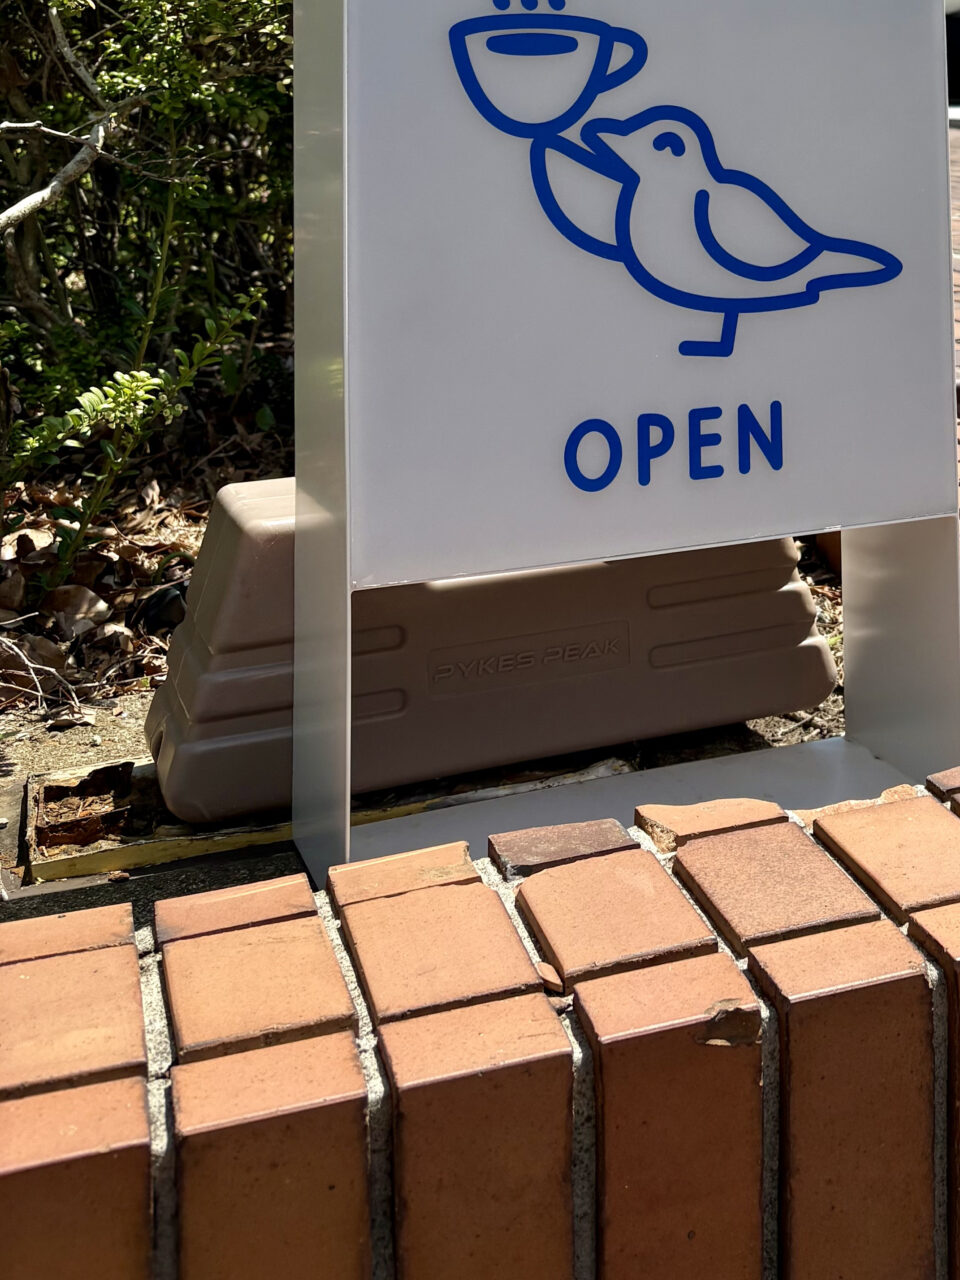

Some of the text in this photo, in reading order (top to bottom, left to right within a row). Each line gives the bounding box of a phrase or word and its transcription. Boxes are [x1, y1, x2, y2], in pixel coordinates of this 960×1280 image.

[564, 400, 784, 492] OPEN
[432, 637, 622, 683] PYKES PEAK
